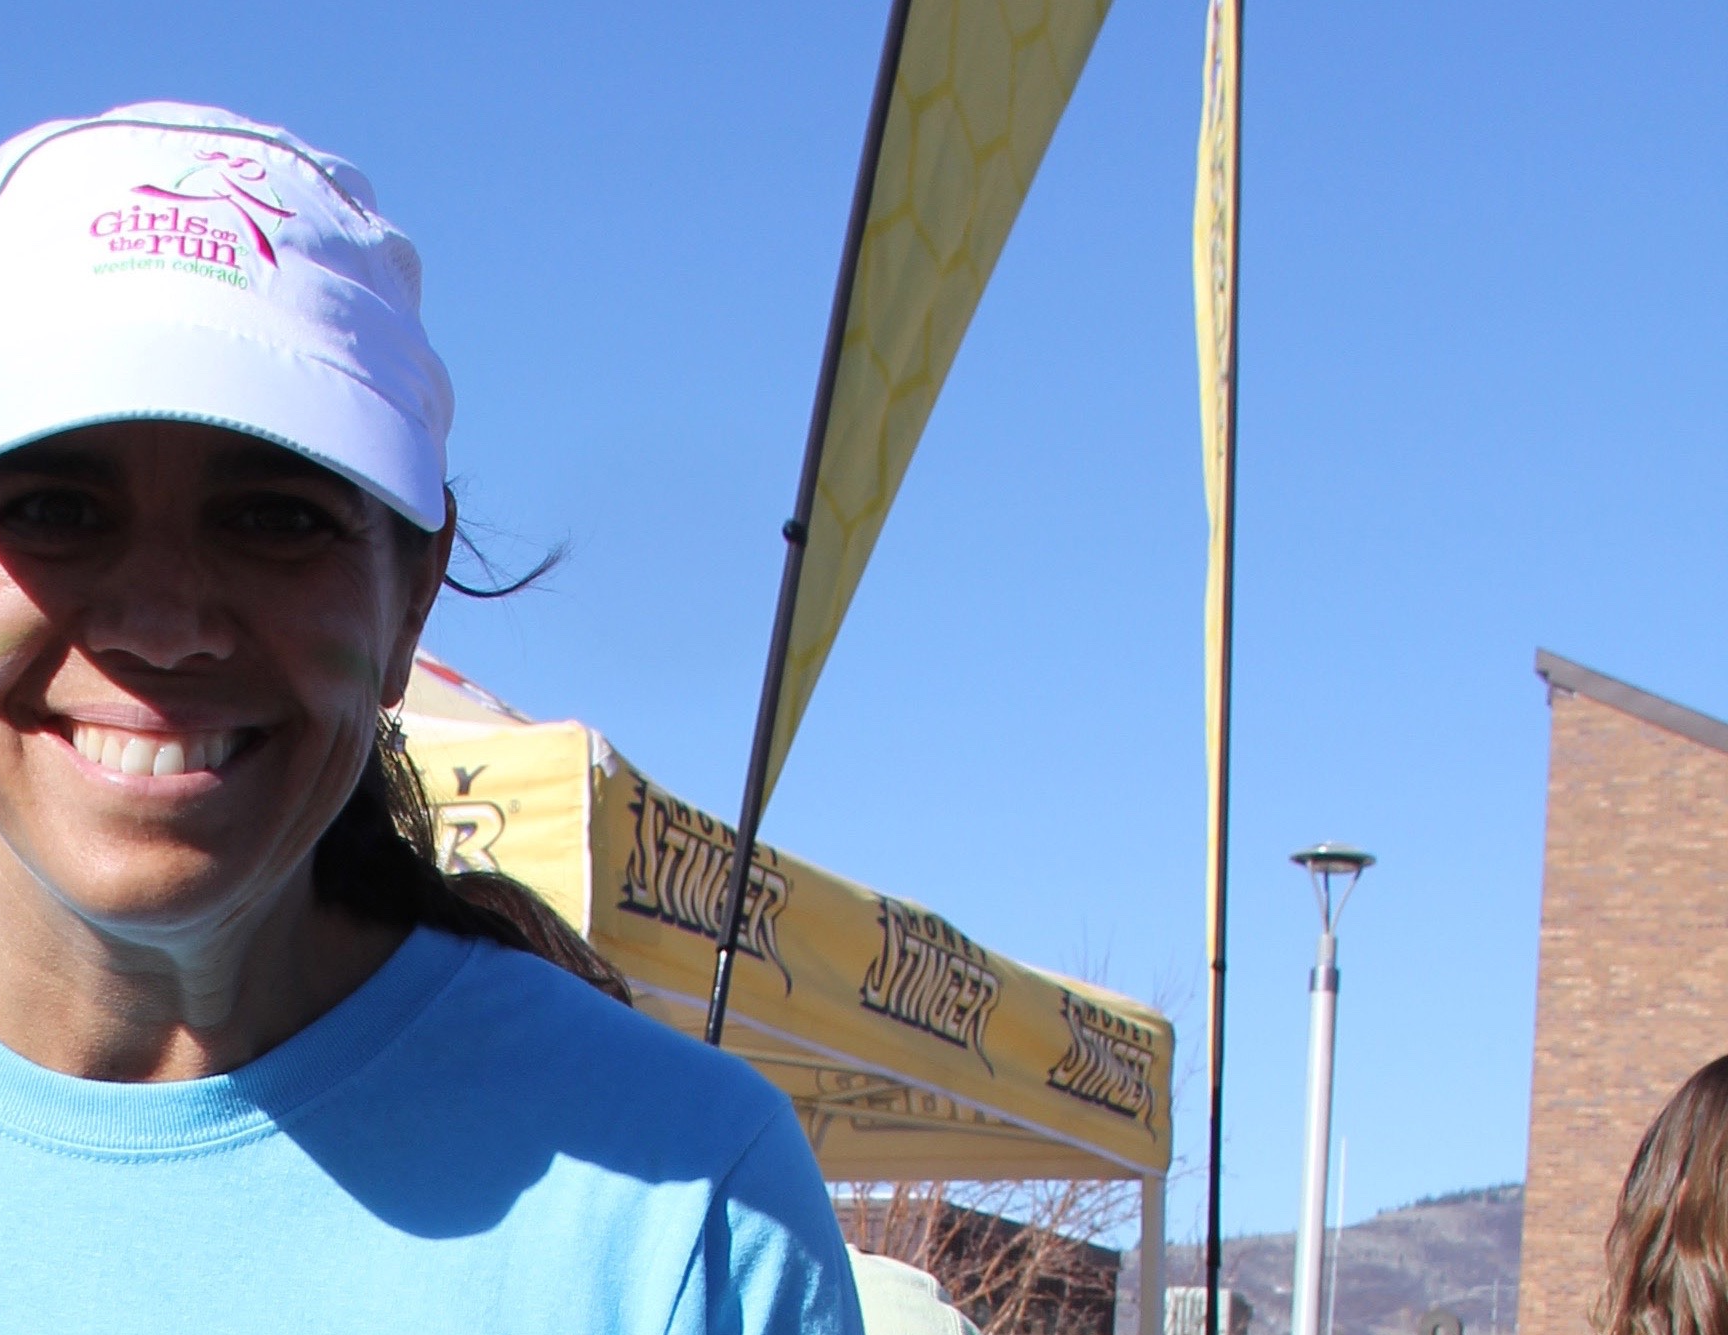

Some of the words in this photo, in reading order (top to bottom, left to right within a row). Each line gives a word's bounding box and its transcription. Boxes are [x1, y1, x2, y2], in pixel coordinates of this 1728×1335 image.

[90, 205, 208, 236] Girls
[211, 229, 237, 243] on
[109, 237, 145, 251] the
[146, 235, 241, 269] run
[93, 258, 165, 275] western
[173, 257, 248, 290] colorado
[860, 897, 999, 1077] STINGER
